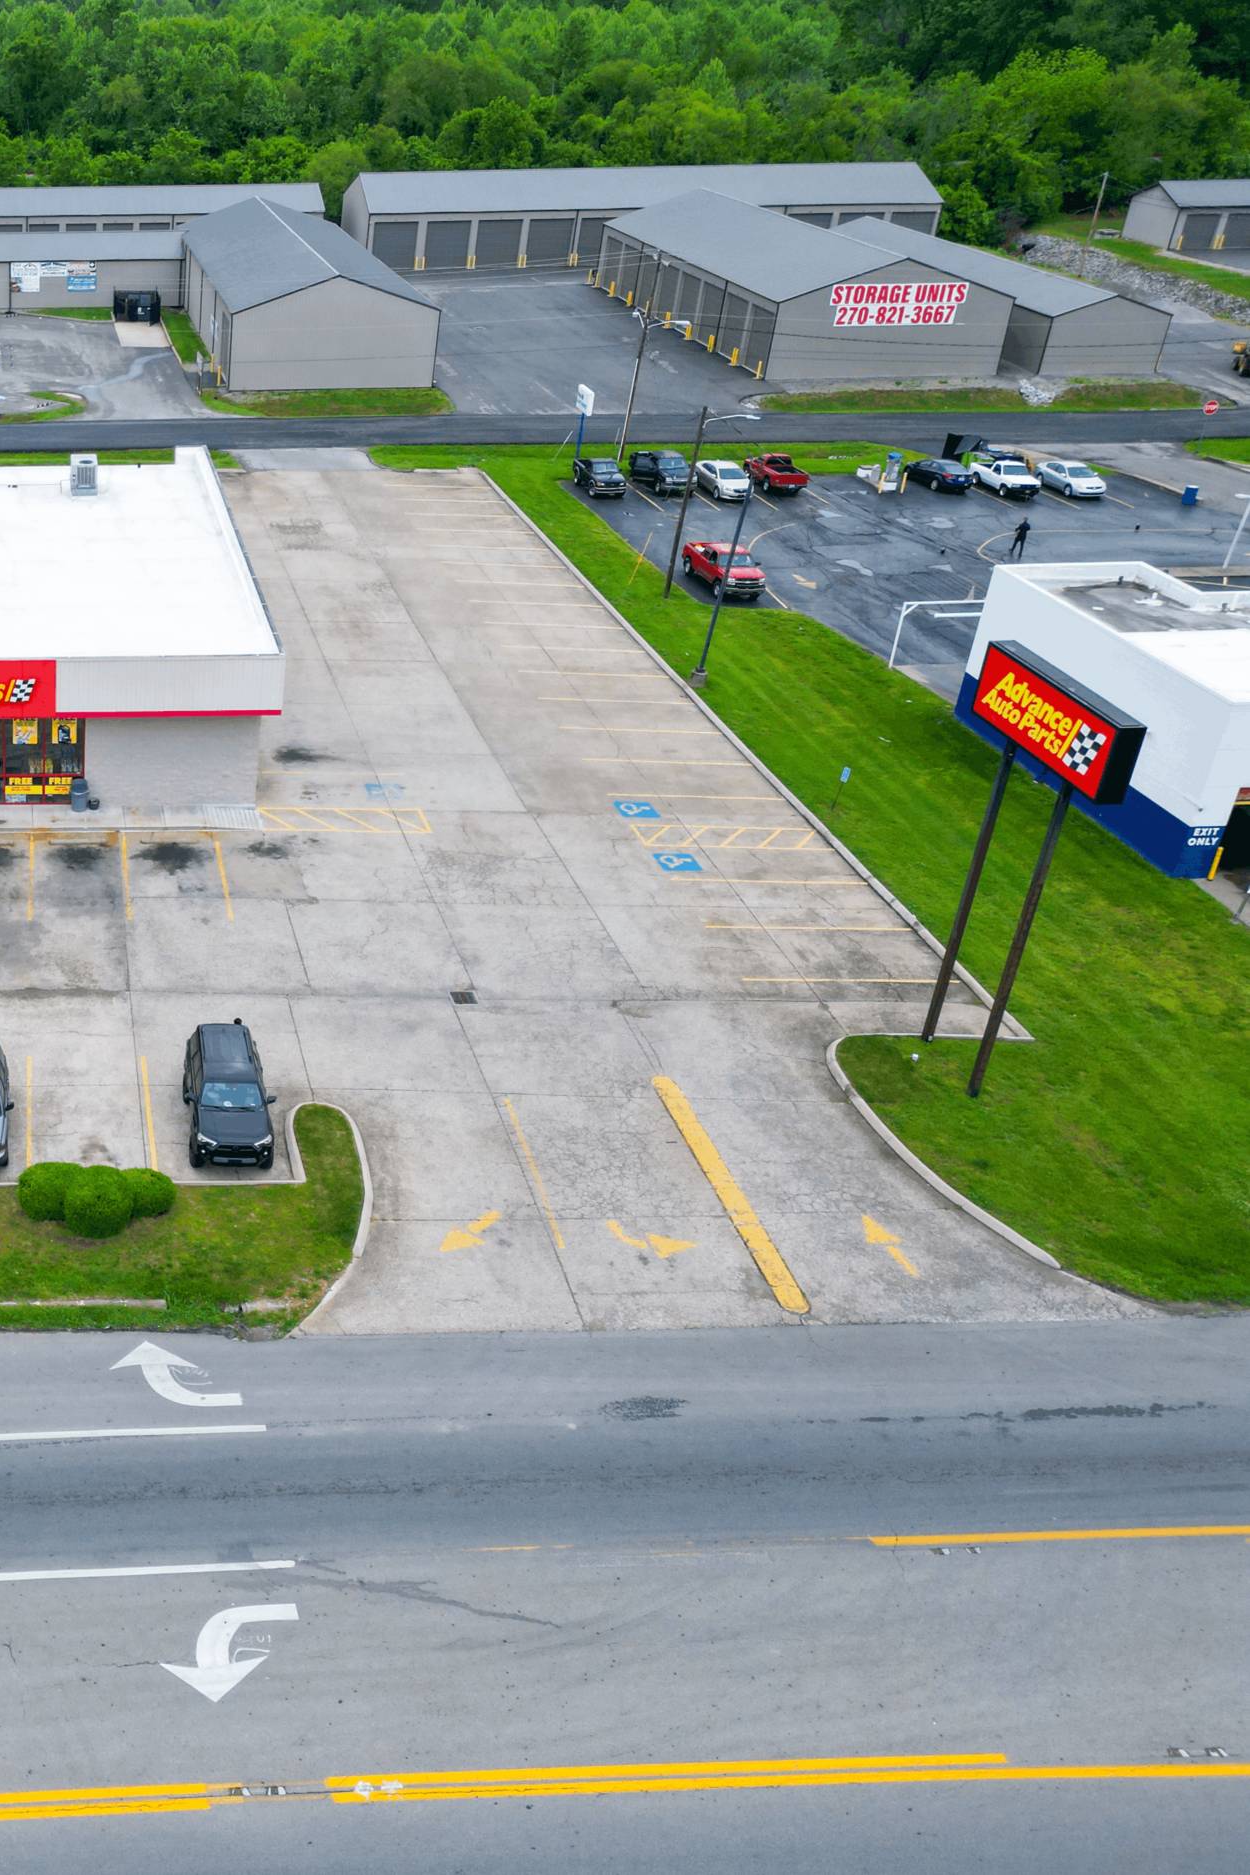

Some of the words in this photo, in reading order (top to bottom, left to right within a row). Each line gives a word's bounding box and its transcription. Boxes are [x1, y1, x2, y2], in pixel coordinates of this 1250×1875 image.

[831, 285, 912, 305] STORAGE
[914, 283, 967, 303] UNITS
[835, 305, 955, 325] 270-821-3667
[994, 672, 1072, 735] Advance
[982, 688, 1021, 727] Auto
[1019, 712, 1063, 755] Parts
[8, 777, 33, 786] FREE
[48, 777, 73, 786] FREE
[1193, 827, 1220, 837] EXIT
[1187, 837, 1219, 846] ONLY
